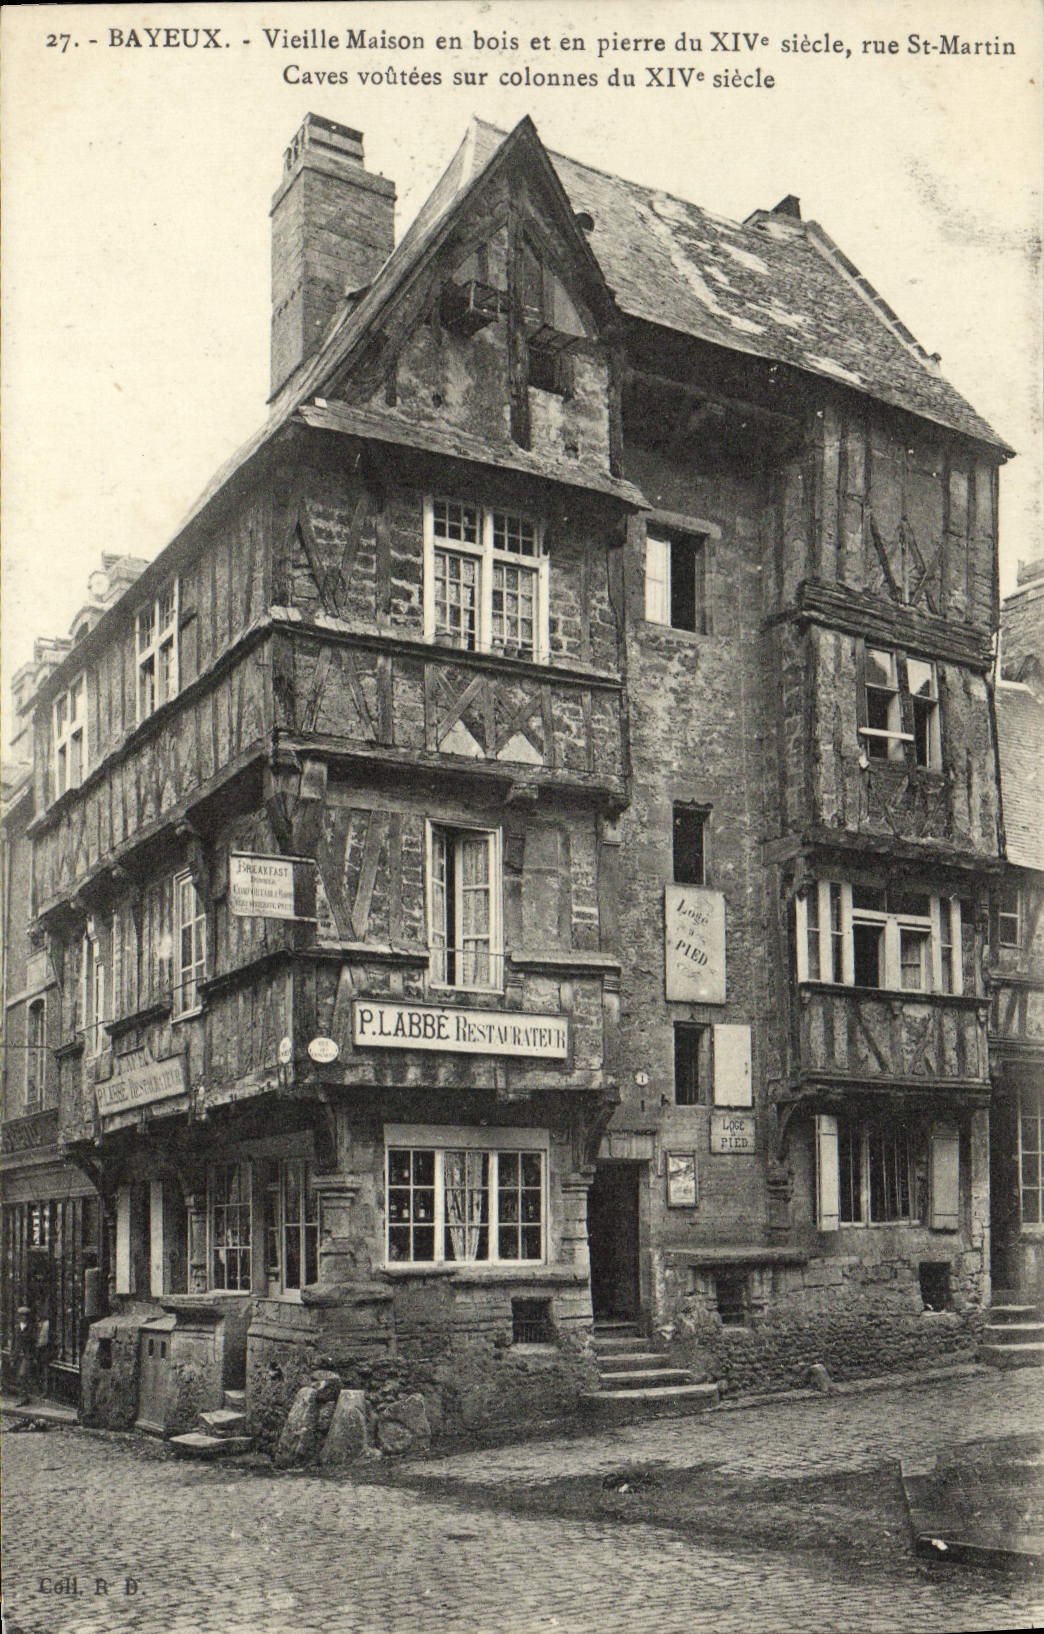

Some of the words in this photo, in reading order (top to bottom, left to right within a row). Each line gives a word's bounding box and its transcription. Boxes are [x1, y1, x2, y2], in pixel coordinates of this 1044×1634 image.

[237, 859, 289, 877] BREAKFAST
[675, 939, 708, 967] PIED
[722, 1118, 745, 1131] LOGE
[720, 1137, 749, 1149] PIED
